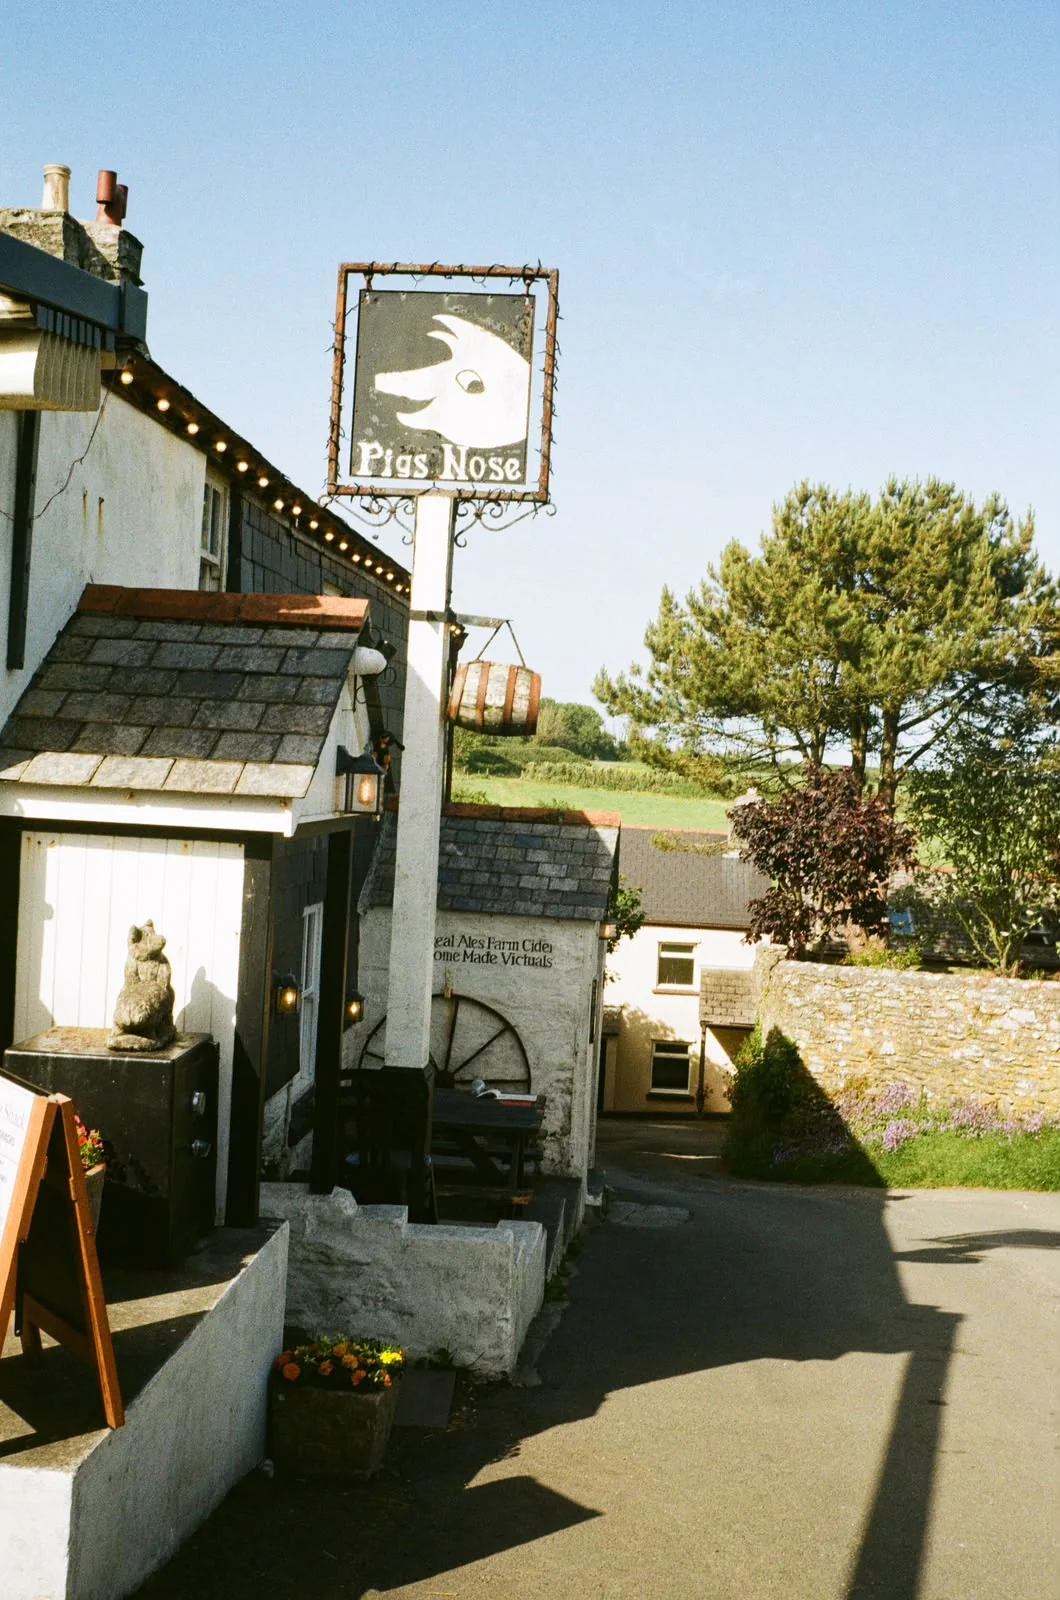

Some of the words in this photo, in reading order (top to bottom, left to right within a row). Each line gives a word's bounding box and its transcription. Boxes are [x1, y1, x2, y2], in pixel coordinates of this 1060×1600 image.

[357, 441, 429, 478] Pigs
[439, 443, 522, 481] Nose
[457, 934, 485, 949] Ales
[487, 936, 519, 951] Farm
[433, 950, 460, 962] ome
[462, 949, 498, 965] Made
[501, 951, 553, 968] Victuals
